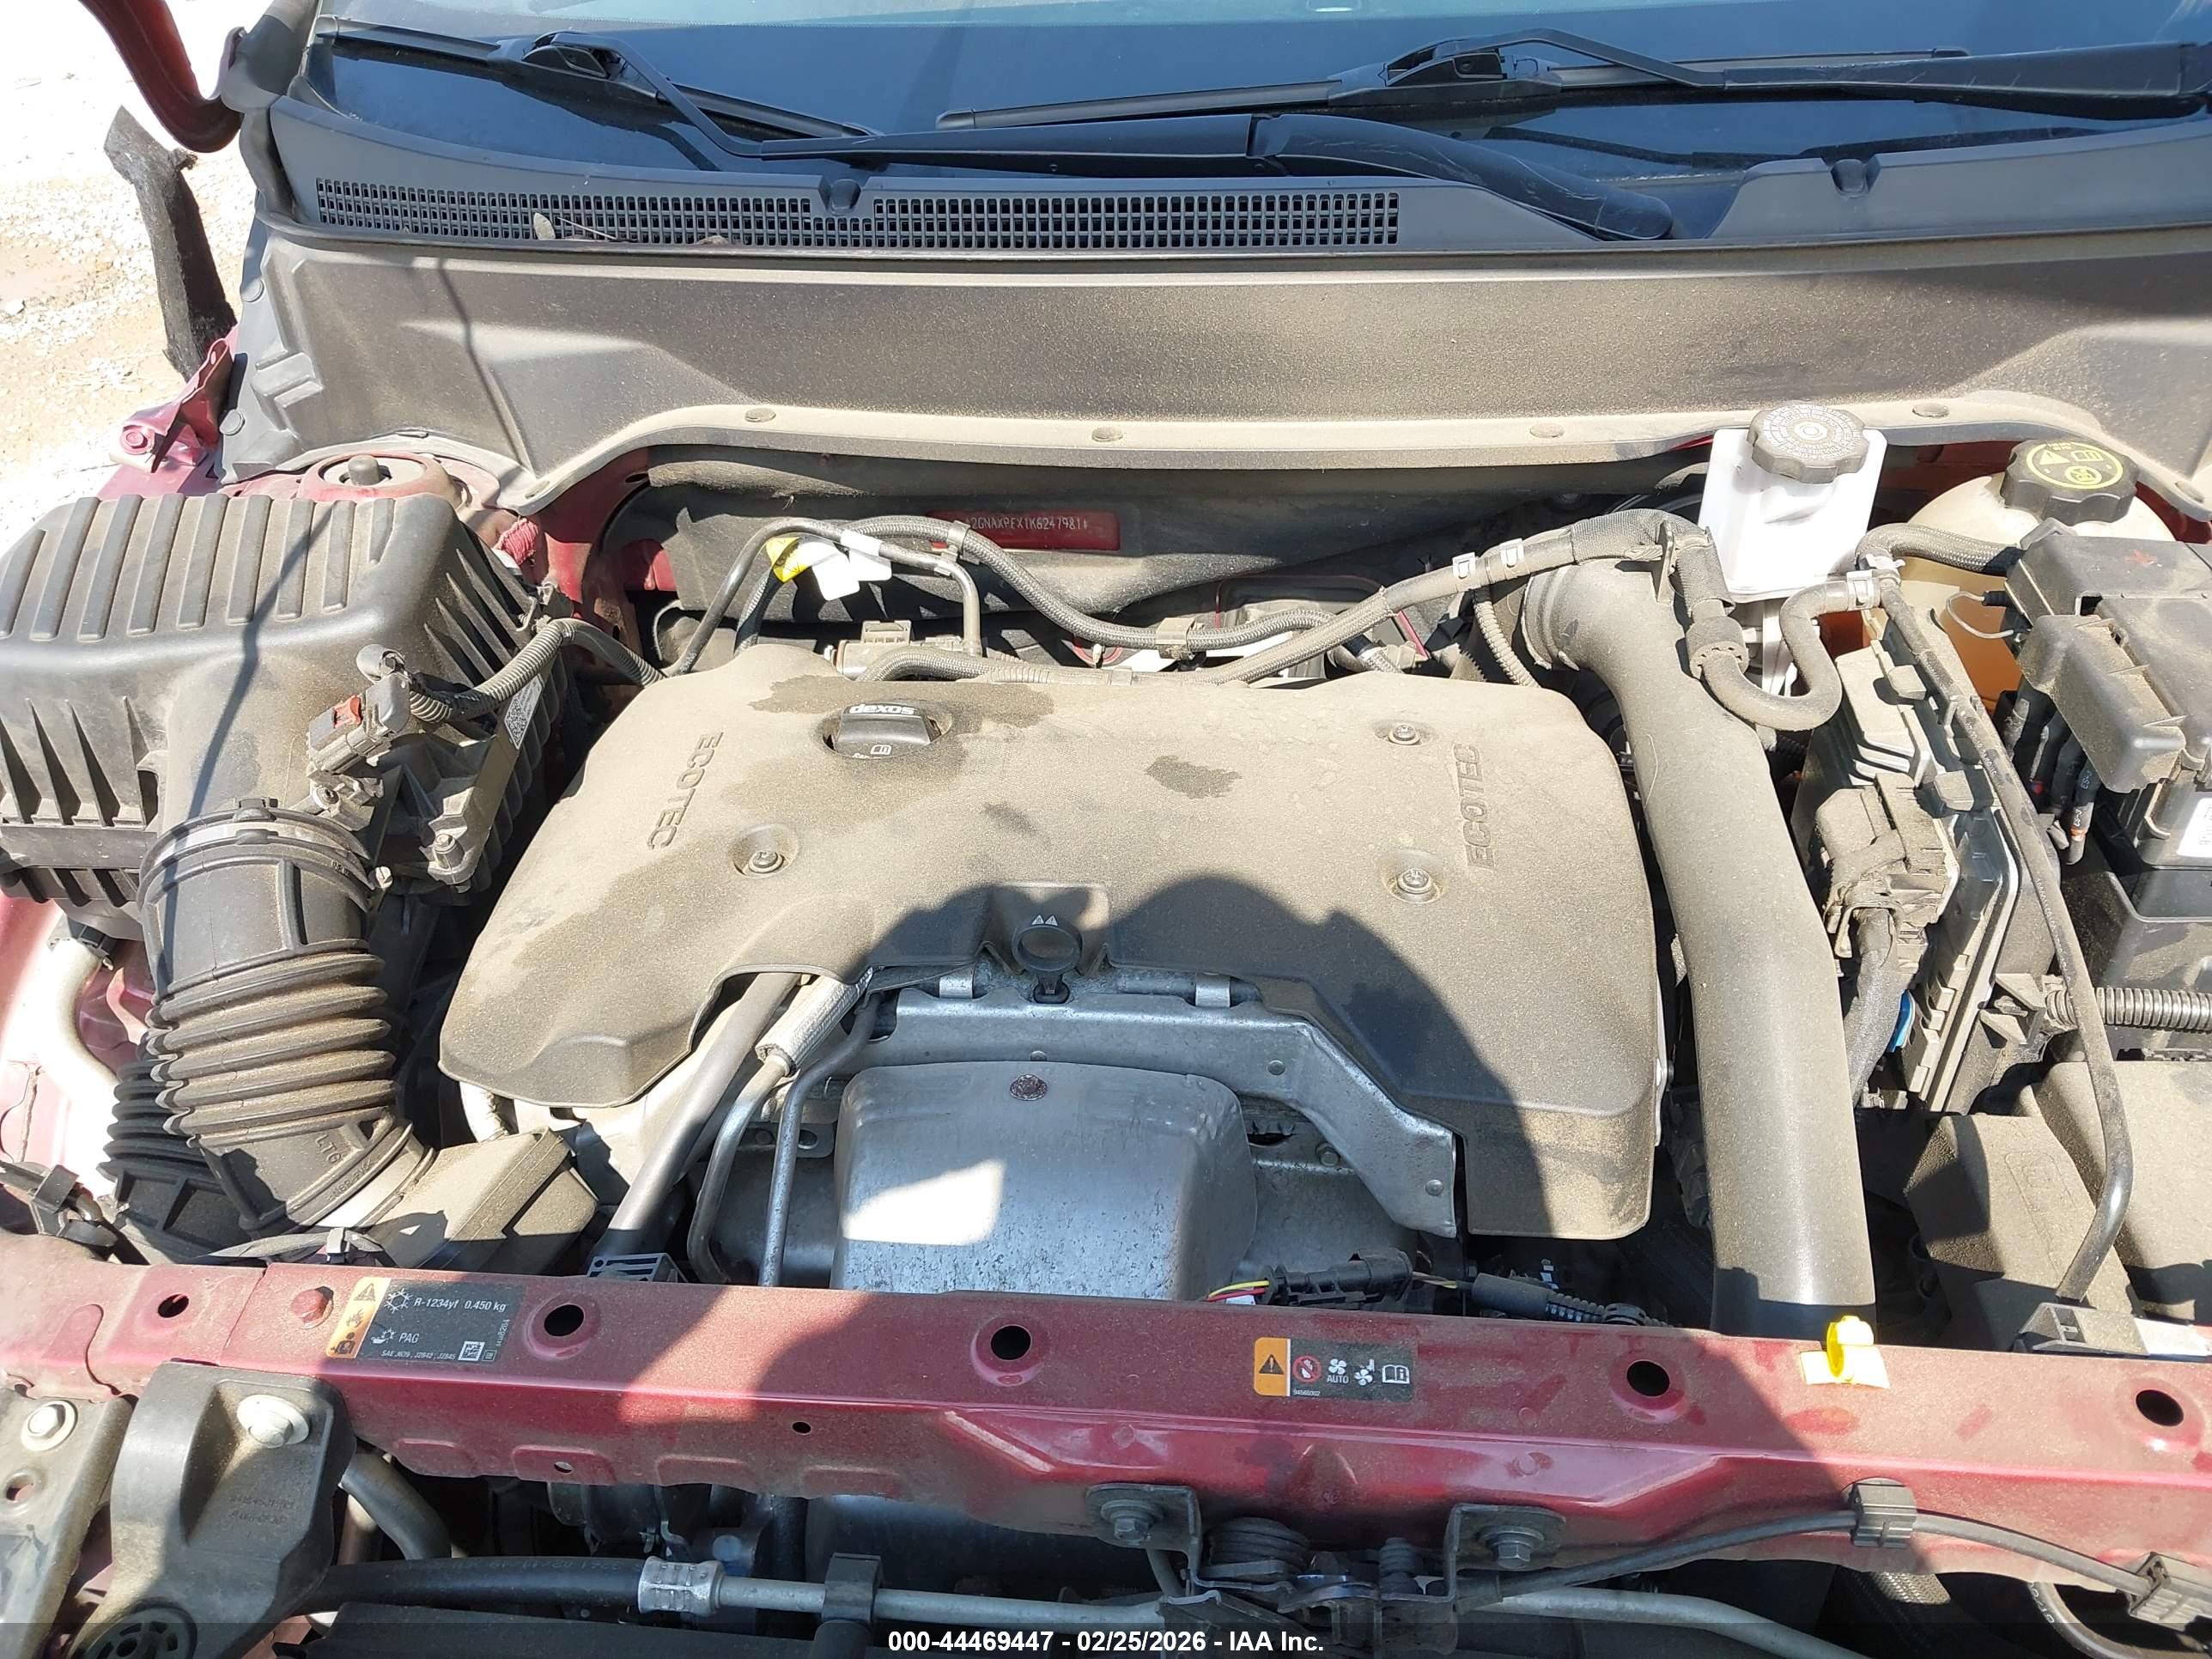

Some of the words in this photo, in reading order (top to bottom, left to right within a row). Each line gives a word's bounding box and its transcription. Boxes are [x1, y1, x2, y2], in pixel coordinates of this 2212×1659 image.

[849, 703, 915, 715] dexos
[646, 731, 725, 850] ECOTEC
[1453, 742, 1496, 868] ECOTEC
[315, 1133, 342, 1164] LTG
[413, 1297, 459, 1310] R-1234yf
[464, 1300, 491, 1311] 0.450
[492, 1300, 507, 1312] kg
[398, 1332, 420, 1344] PAG
[1326, 1374, 1349, 1383] AUTO
